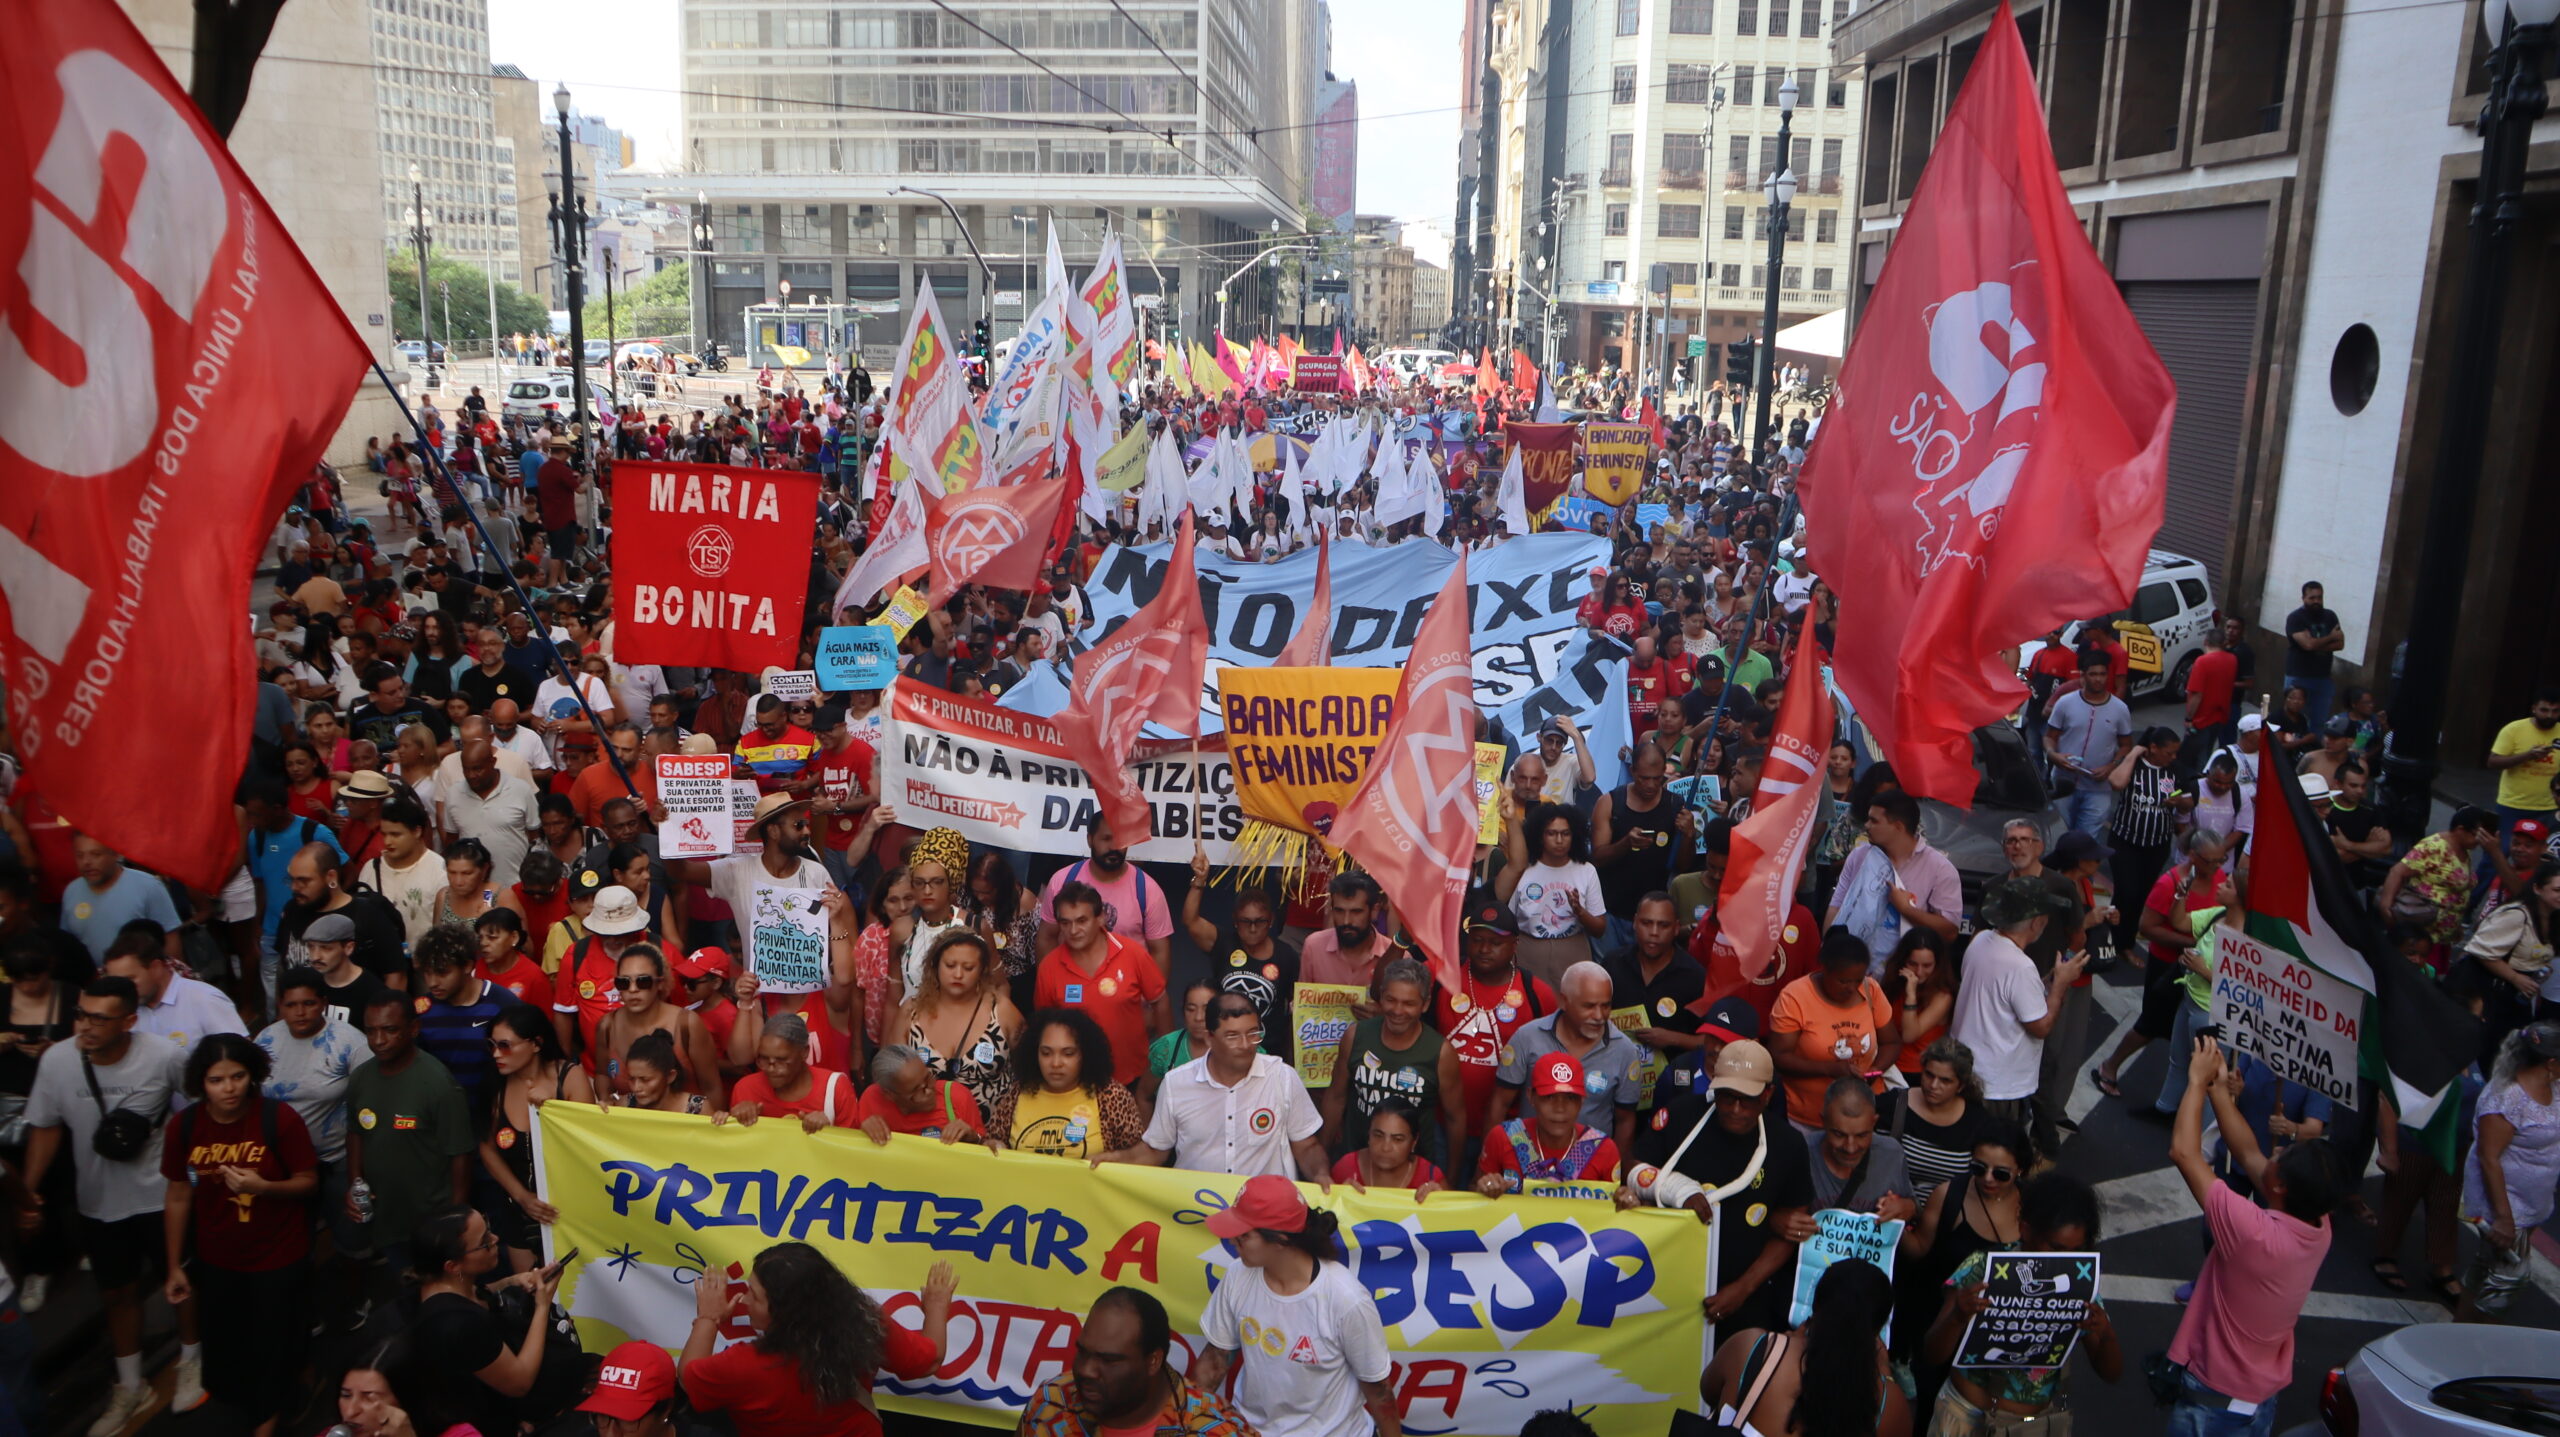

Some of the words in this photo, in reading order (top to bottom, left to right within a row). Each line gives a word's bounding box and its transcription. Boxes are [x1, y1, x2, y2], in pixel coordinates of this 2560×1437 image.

[1590, 429, 1650, 445] BANCADA
[1586, 453, 1644, 470] FEMINISTA
[649, 472, 780, 523] MARIA
[633, 584, 776, 637] BONITA
[826, 641, 851, 653] ÁGUA
[854, 643, 880, 652] MAIS
[2132, 642, 2156, 657] Box
[831, 656, 855, 666] CARA
[858, 653, 877, 664] NÃO
[772, 675, 813, 684] CONTRA
[910, 692, 928, 714] SE
[931, 696, 1018, 741] PRIVATIZAR,
[1022, 721, 1032, 740] O
[1226, 693, 1393, 738] BANCADA
[904, 733, 980, 771] NÃO
[988, 748, 1013, 781] À
[1234, 742, 1377, 786] FEMINIST
[662, 762, 725, 776] SABESP
[680, 805, 725, 813] AUMENTAR!
[909, 788, 940, 809] AÇÃO
[942, 792, 992, 820] PETISTA
[1004, 813, 1019, 821] PT
[781, 926, 794, 936] SE
[758, 934, 818, 953] PRIVATIZAR
[758, 949, 766, 959] A
[767, 950, 802, 964] CONTA
[803, 956, 816, 964] VAI
[2221, 937, 2263, 965] NÃO
[2281, 964, 2313, 990] AO
[757, 962, 818, 981] AUMENTAR
[1298, 988, 1360, 1005] PRIVATIZAR
[2220, 957, 2328, 1022] APARTHEID
[2335, 1012, 2357, 1042] DA
[2216, 978, 2265, 1015] ÁGUA
[2279, 1012, 2307, 1036] NA
[1299, 1022, 1356, 1041] SABES
[2225, 1003, 2334, 1075] PALESTINA
[2235, 1030, 2265, 1061] EM
[395, 1119, 416, 1128] CTB
[1873, 1221, 1883, 1234] A
[600, 1159, 1089, 1276] PRIVATIZAR
[1101, 1220, 1161, 1284] A
[1205, 1219, 1656, 1332] BESP
[1857, 1231, 1884, 1248] NÃO
[1826, 1242, 1852, 1258] SUA
[1865, 1249, 1881, 1263] DO
[1987, 1296, 2043, 1309] NUNES
[2047, 1297, 2084, 1310] QUER
[1983, 1307, 2081, 1321] TRANSFORMAR
[1979, 1321, 1989, 1330] A
[1988, 1333, 2006, 1343] NA
[2009, 1331, 2054, 1344] enel
[601, 1365, 635, 1384] CUT
